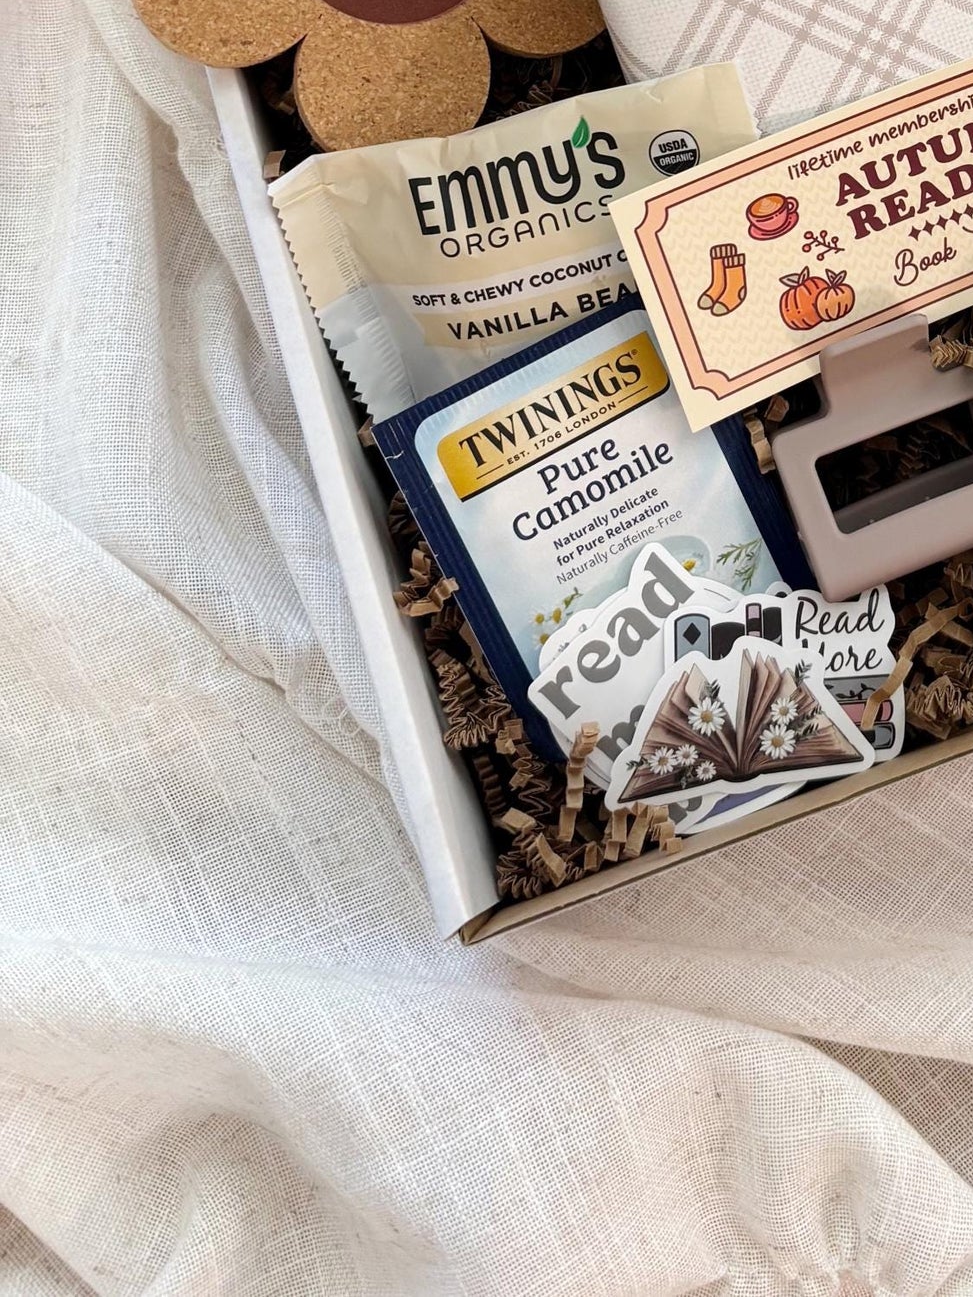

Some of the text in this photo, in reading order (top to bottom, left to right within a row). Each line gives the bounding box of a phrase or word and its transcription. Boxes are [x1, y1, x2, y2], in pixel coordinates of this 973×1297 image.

[658, 138, 688, 153] USDA
[659, 152, 694, 166] ORGANIC
[787, 140, 864, 180] lifetime
[440, 195, 615, 258] ORGANICS
[412, 294, 446, 307] SOFT
[450, 293, 462, 306] &
[463, 278, 525, 304] CHEWY
[529, 254, 613, 288] COCONUT
[893, 237, 957, 287] Book
[447, 301, 569, 341] VANILLA
[459, 353, 641, 468] TWININGS
[507, 401, 617, 465] EST. 1706 LONDON
[512, 442, 674, 541] Camomile
[537, 438, 620, 495] Pure
[553, 487, 659, 550] Naturally Delicate
[556, 499, 669, 566] for Pure Relaxation
[556, 509, 683, 585] Naturally Caffeine-Free
[538, 551, 695, 720] read
[796, 588, 885, 640] Read
[802, 638, 883, 672] ore
